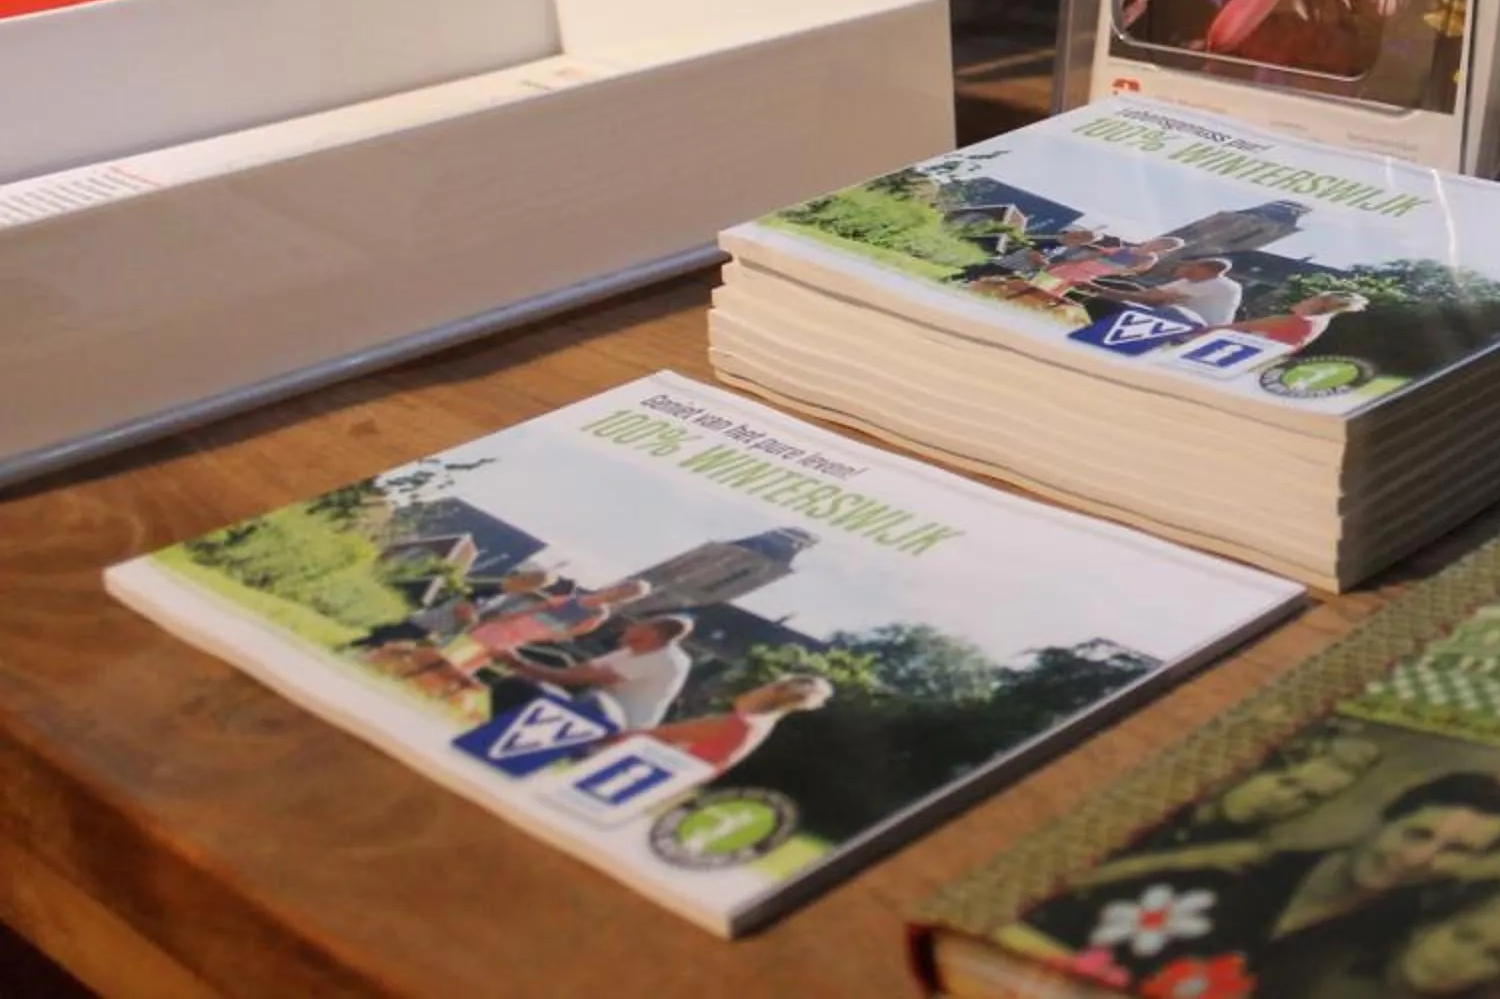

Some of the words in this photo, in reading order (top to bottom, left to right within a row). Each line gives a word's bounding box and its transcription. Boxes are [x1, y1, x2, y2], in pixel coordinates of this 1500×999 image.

[1080, 116, 1172, 152] 100%
[1168, 142, 1431, 217] WINTERSWIJK
[580, 408, 702, 458] 100%
[677, 442, 968, 557] WINTERSWIJK
